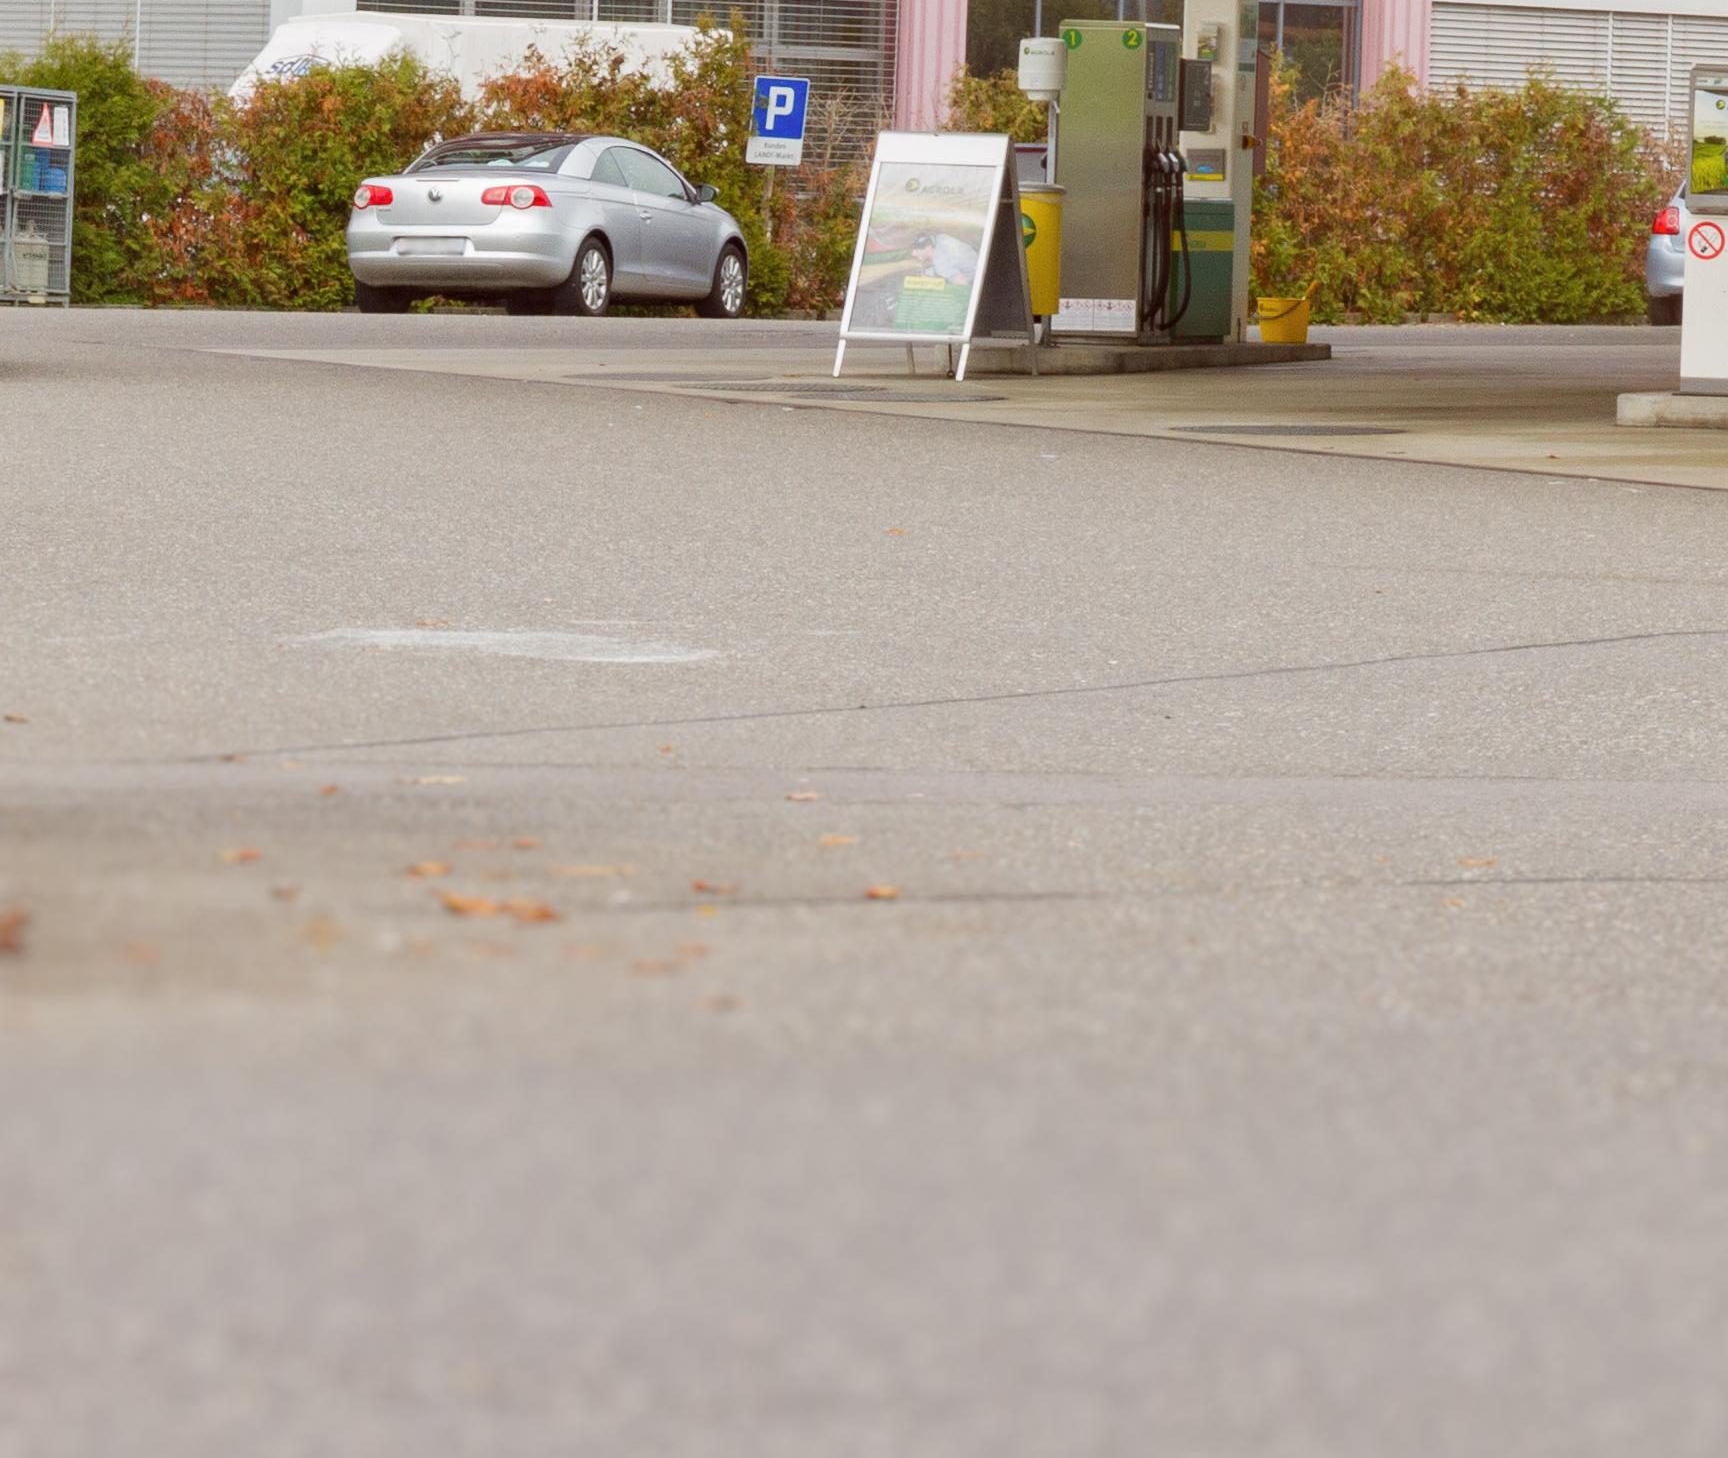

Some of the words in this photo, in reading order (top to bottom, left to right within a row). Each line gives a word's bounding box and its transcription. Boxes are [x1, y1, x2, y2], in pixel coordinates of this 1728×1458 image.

[1069, 30, 1076, 46] 1
[1127, 30, 1138, 47] 2
[765, 86, 795, 131] P
